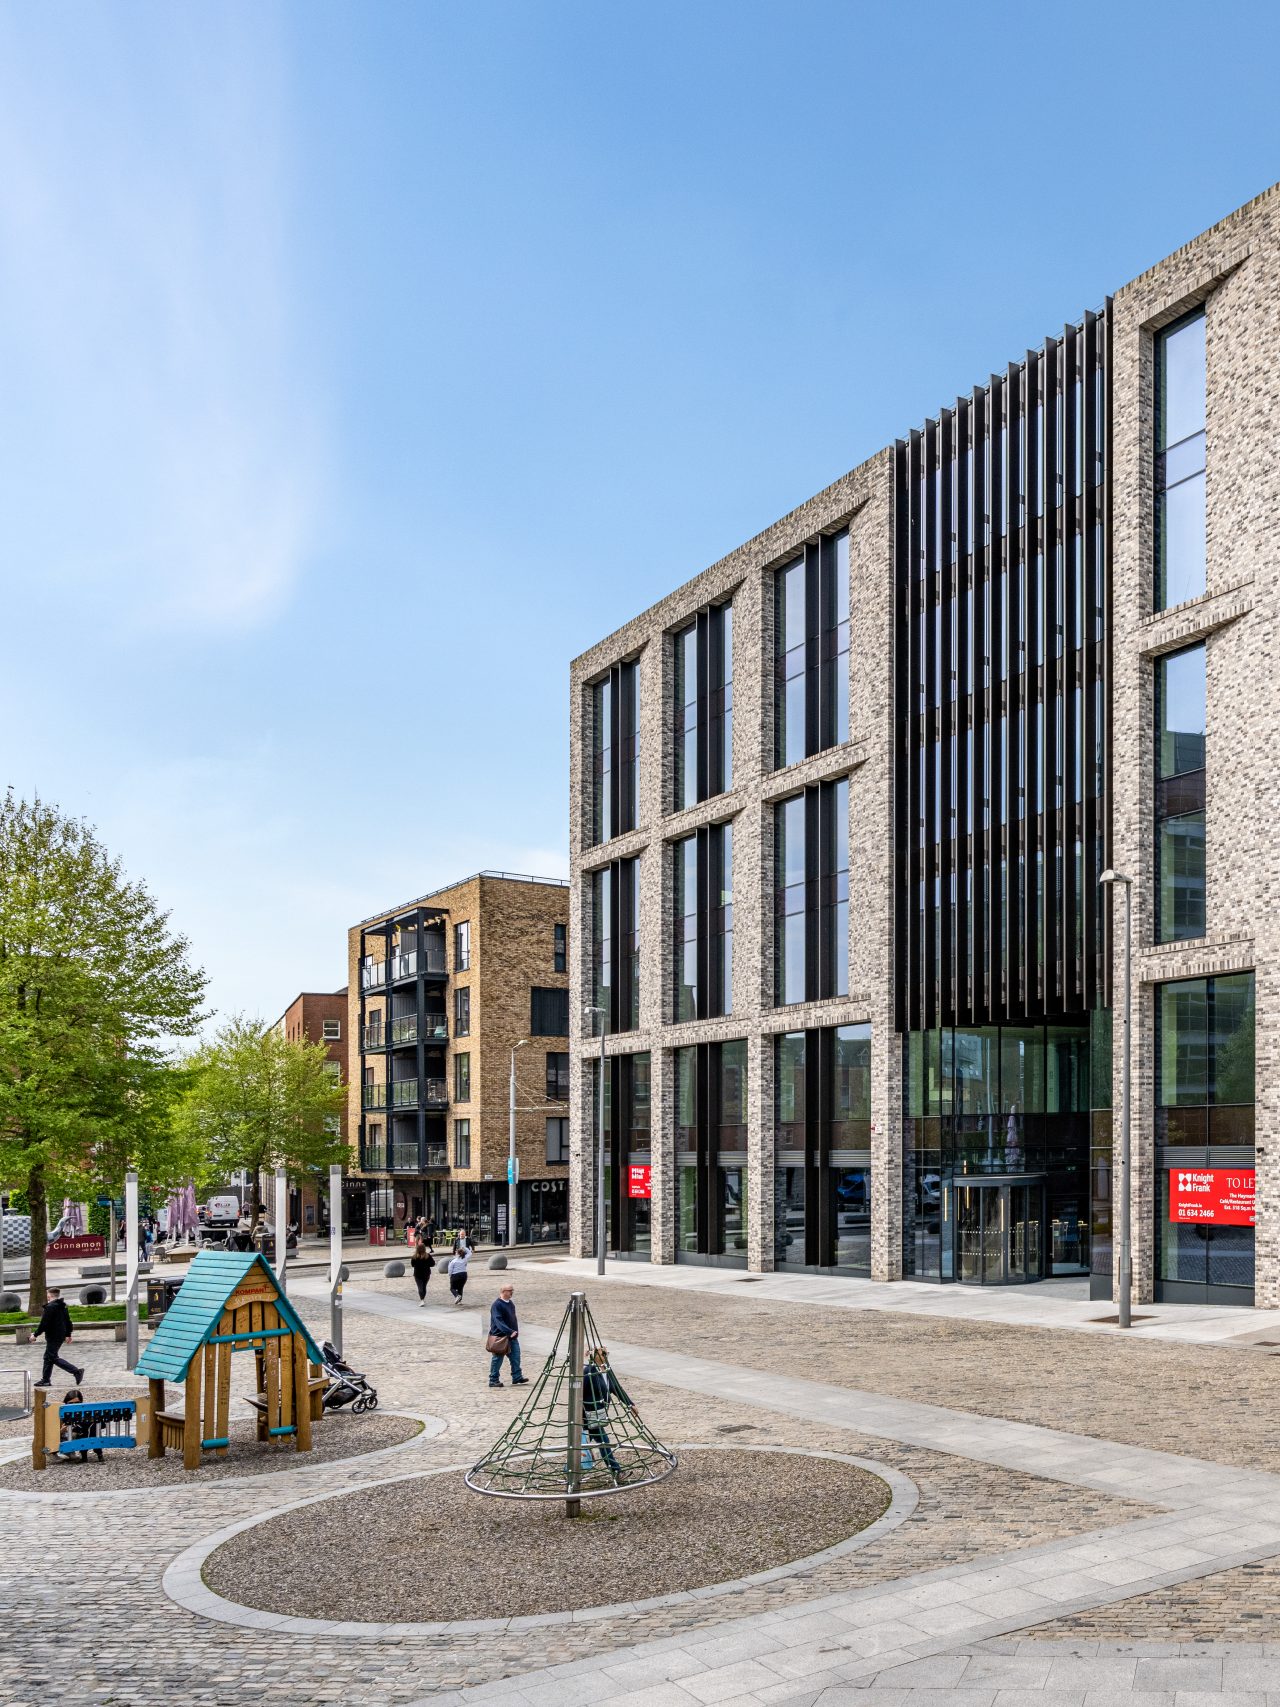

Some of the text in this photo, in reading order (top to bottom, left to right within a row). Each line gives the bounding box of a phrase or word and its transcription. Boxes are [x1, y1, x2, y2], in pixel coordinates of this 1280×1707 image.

[1192, 1173, 1214, 1184] Knight
[1226, 1177, 1255, 1189] TO LE
[1192, 1183, 1211, 1192] Frank
[1187, 1209, 1198, 1217] 634
[53, 1241, 101, 1250] Cinnamon
